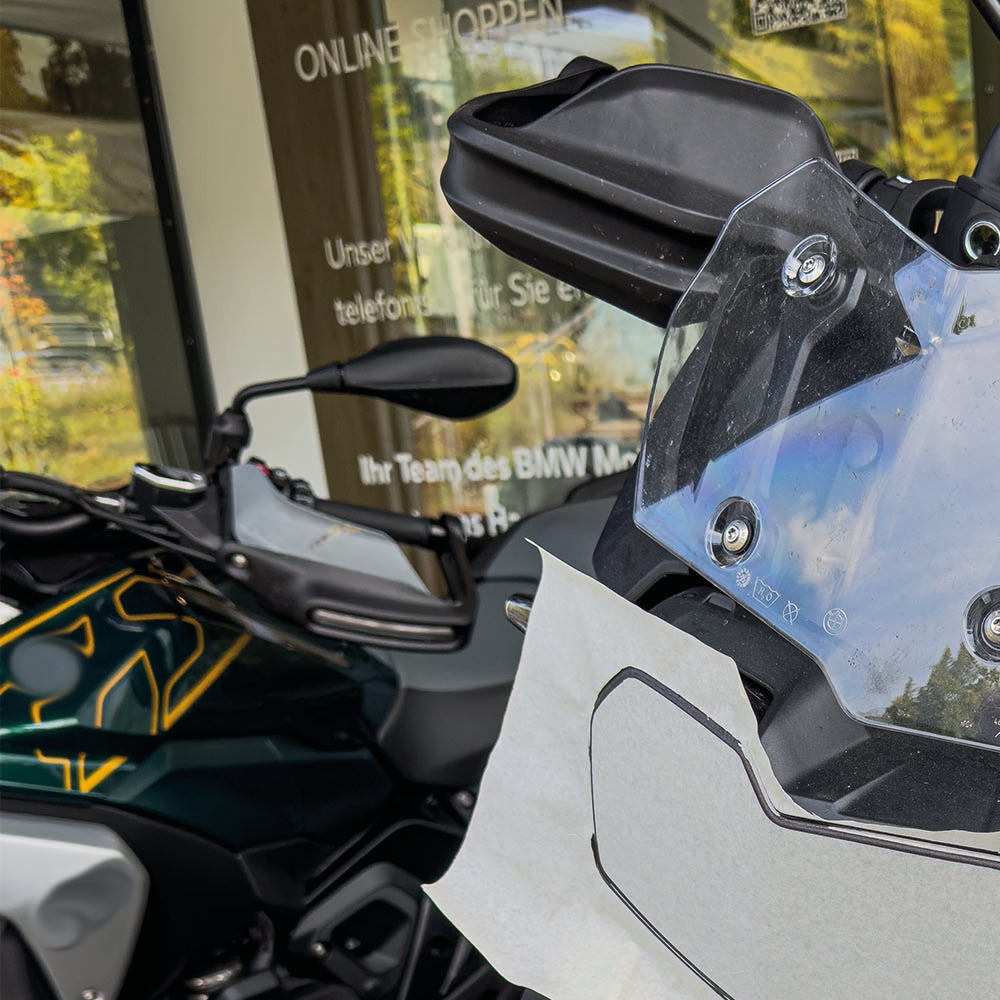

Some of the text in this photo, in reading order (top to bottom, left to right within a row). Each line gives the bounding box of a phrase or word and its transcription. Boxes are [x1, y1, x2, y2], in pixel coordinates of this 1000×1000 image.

[294, 23, 400, 82] ONLINE
[323, 237, 393, 270] Unser
[507, 271, 552, 307] Sie
[357, 454, 393, 485] Ihr
[393, 452, 463, 486] Team
[463, 449, 513, 483] des
[513, 445, 589, 480] BMW
